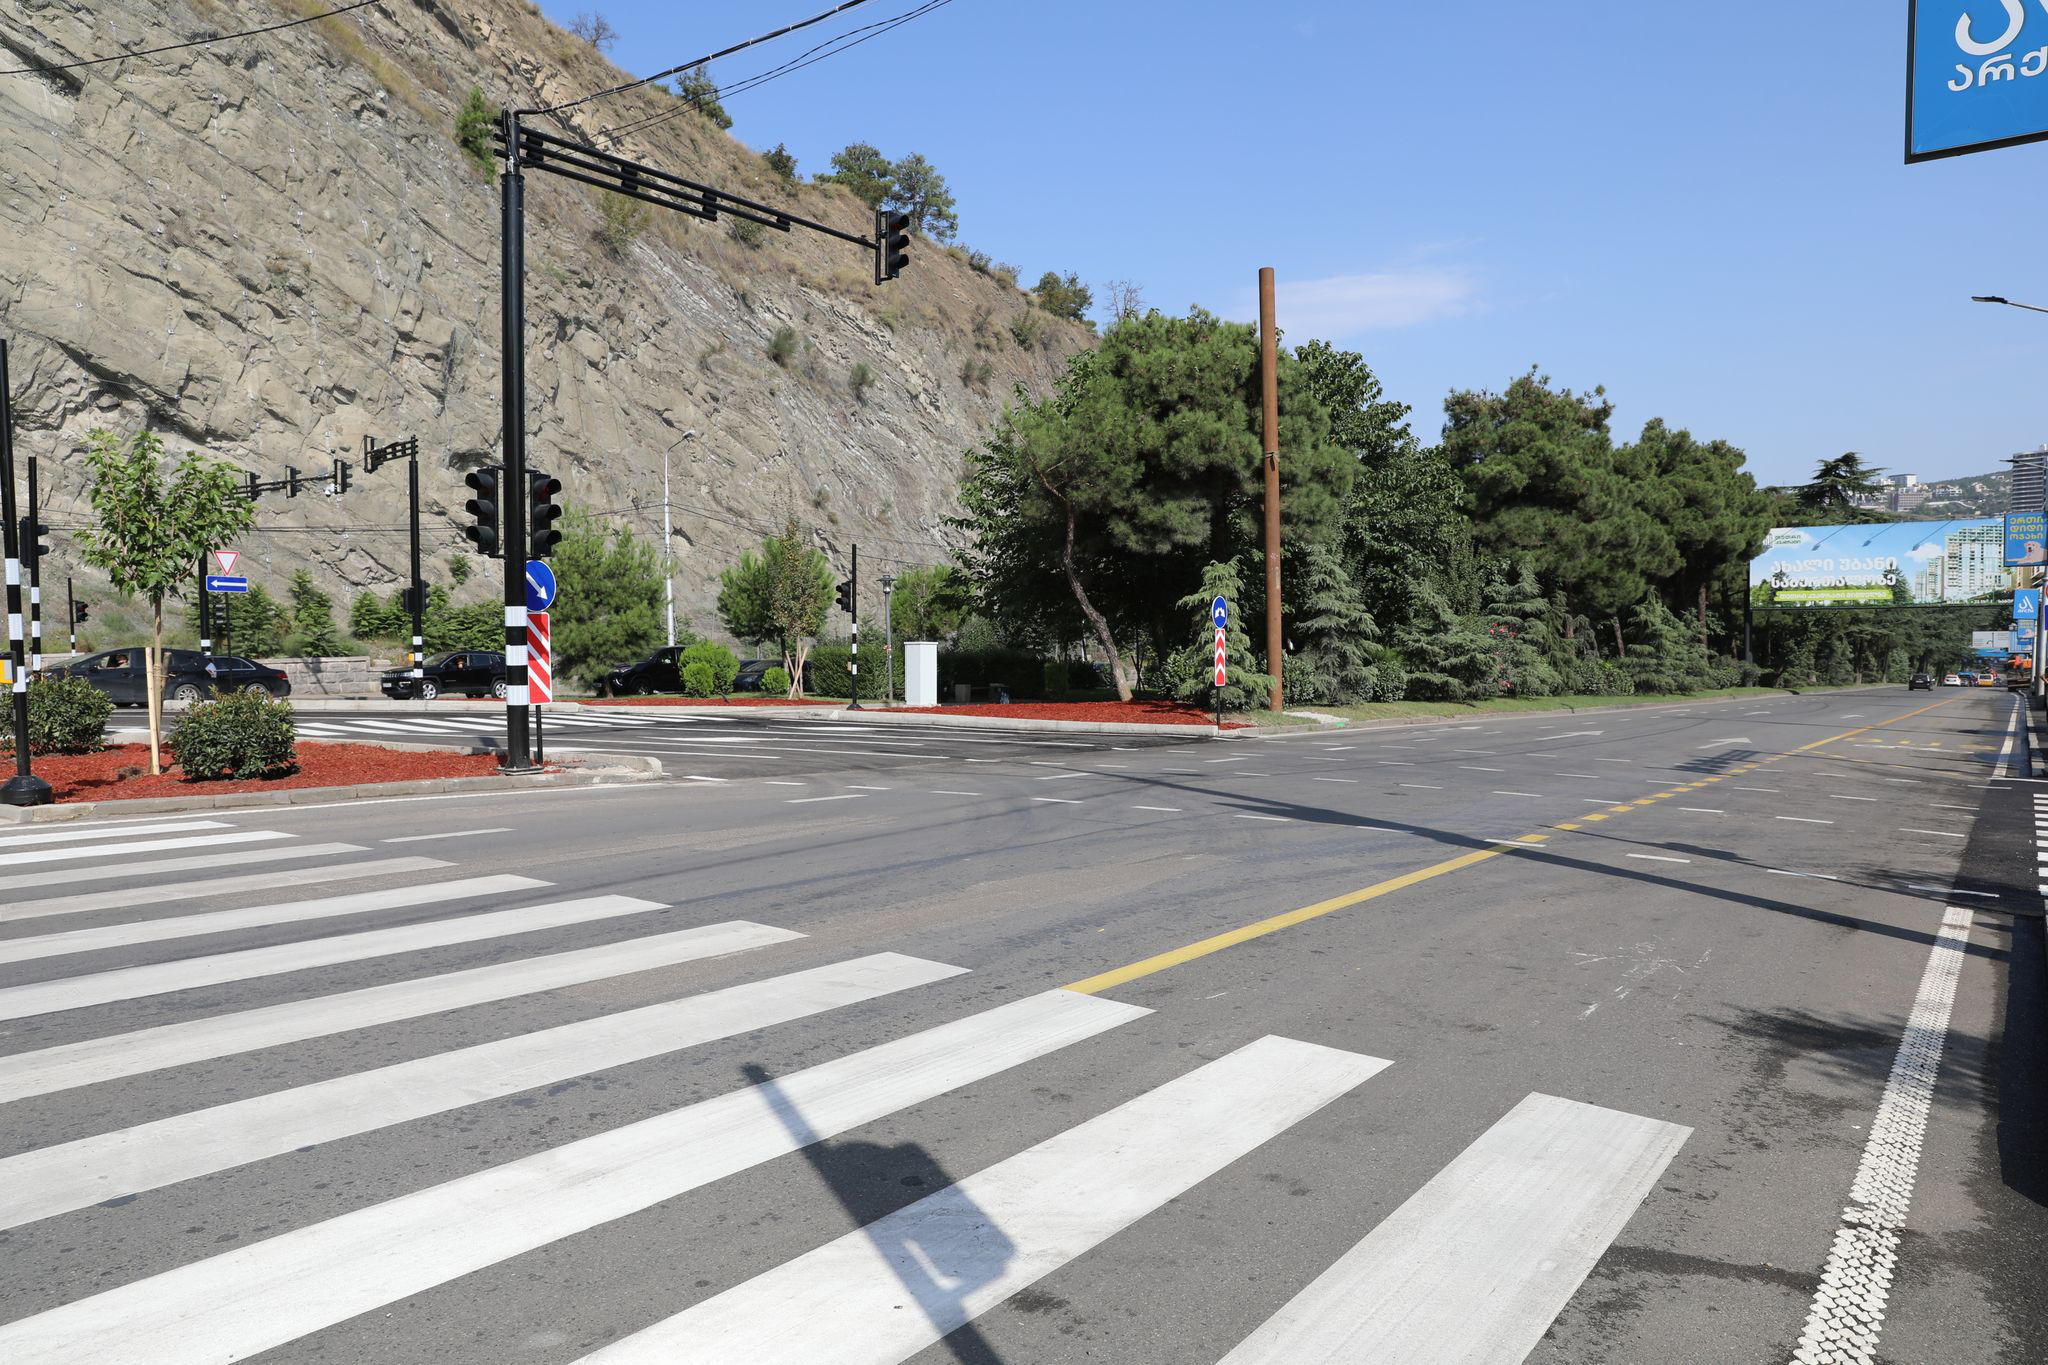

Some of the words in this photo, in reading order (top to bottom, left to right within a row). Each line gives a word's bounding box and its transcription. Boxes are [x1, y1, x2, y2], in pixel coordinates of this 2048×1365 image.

[2010, 524, 2043, 532] დიდი
[1771, 558, 1834, 573] ახალი
[1840, 556, 1897, 571] უბანი
